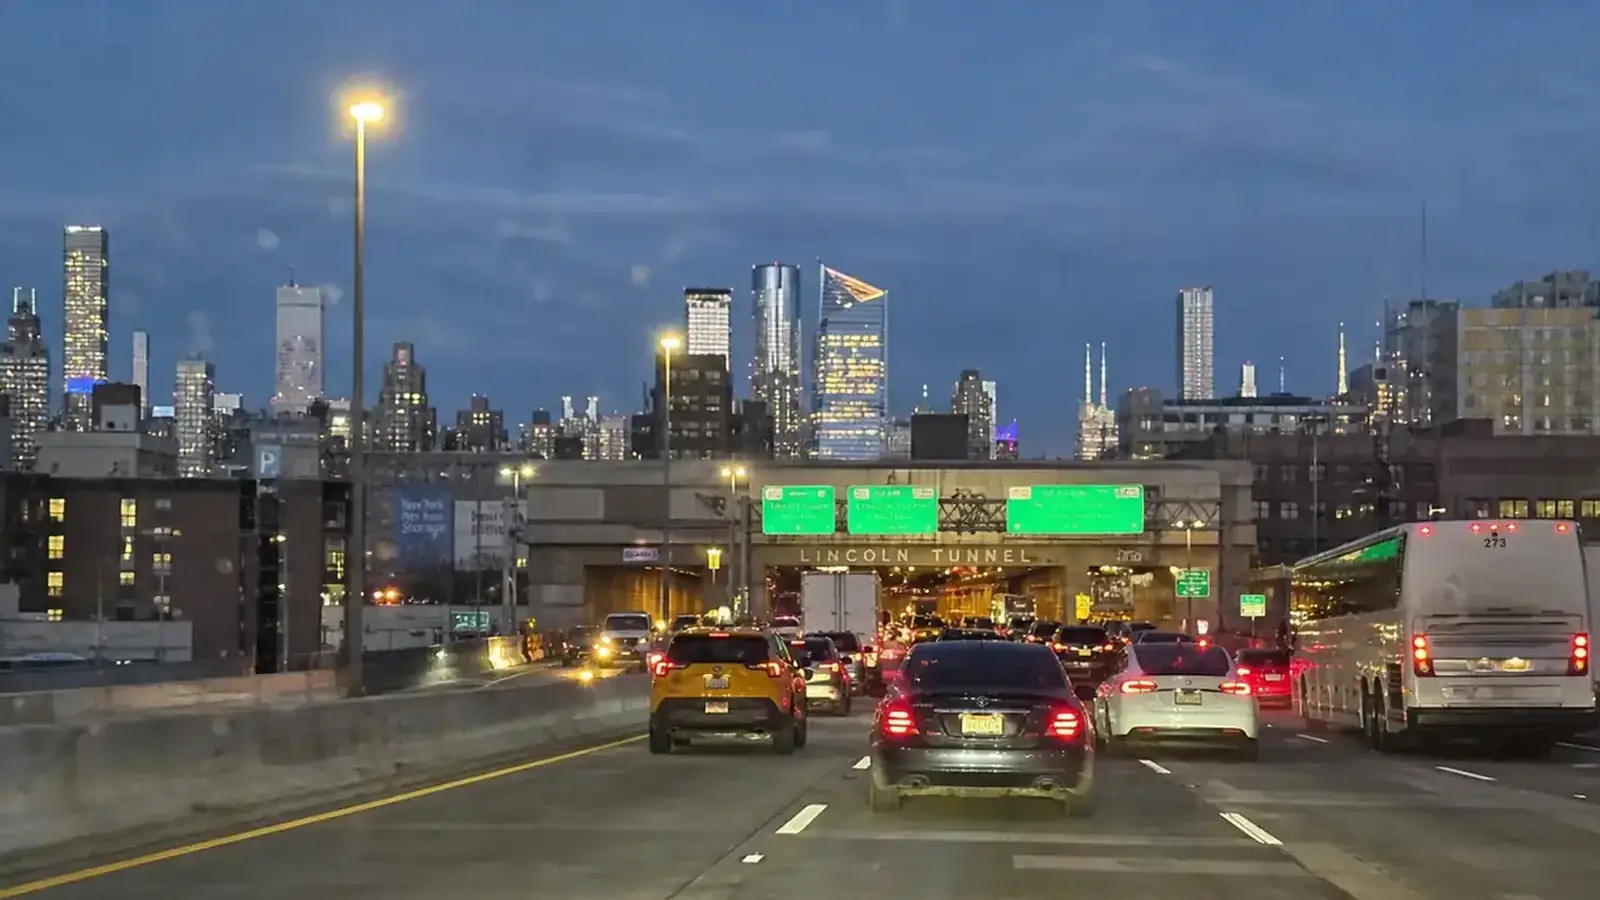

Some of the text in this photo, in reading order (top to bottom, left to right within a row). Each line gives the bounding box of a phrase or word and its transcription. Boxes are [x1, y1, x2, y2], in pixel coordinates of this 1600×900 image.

[261, 451, 276, 474] P
[1484, 537, 1506, 548] 273
[800, 548, 1032, 563] LINCOLN TUNNEL
